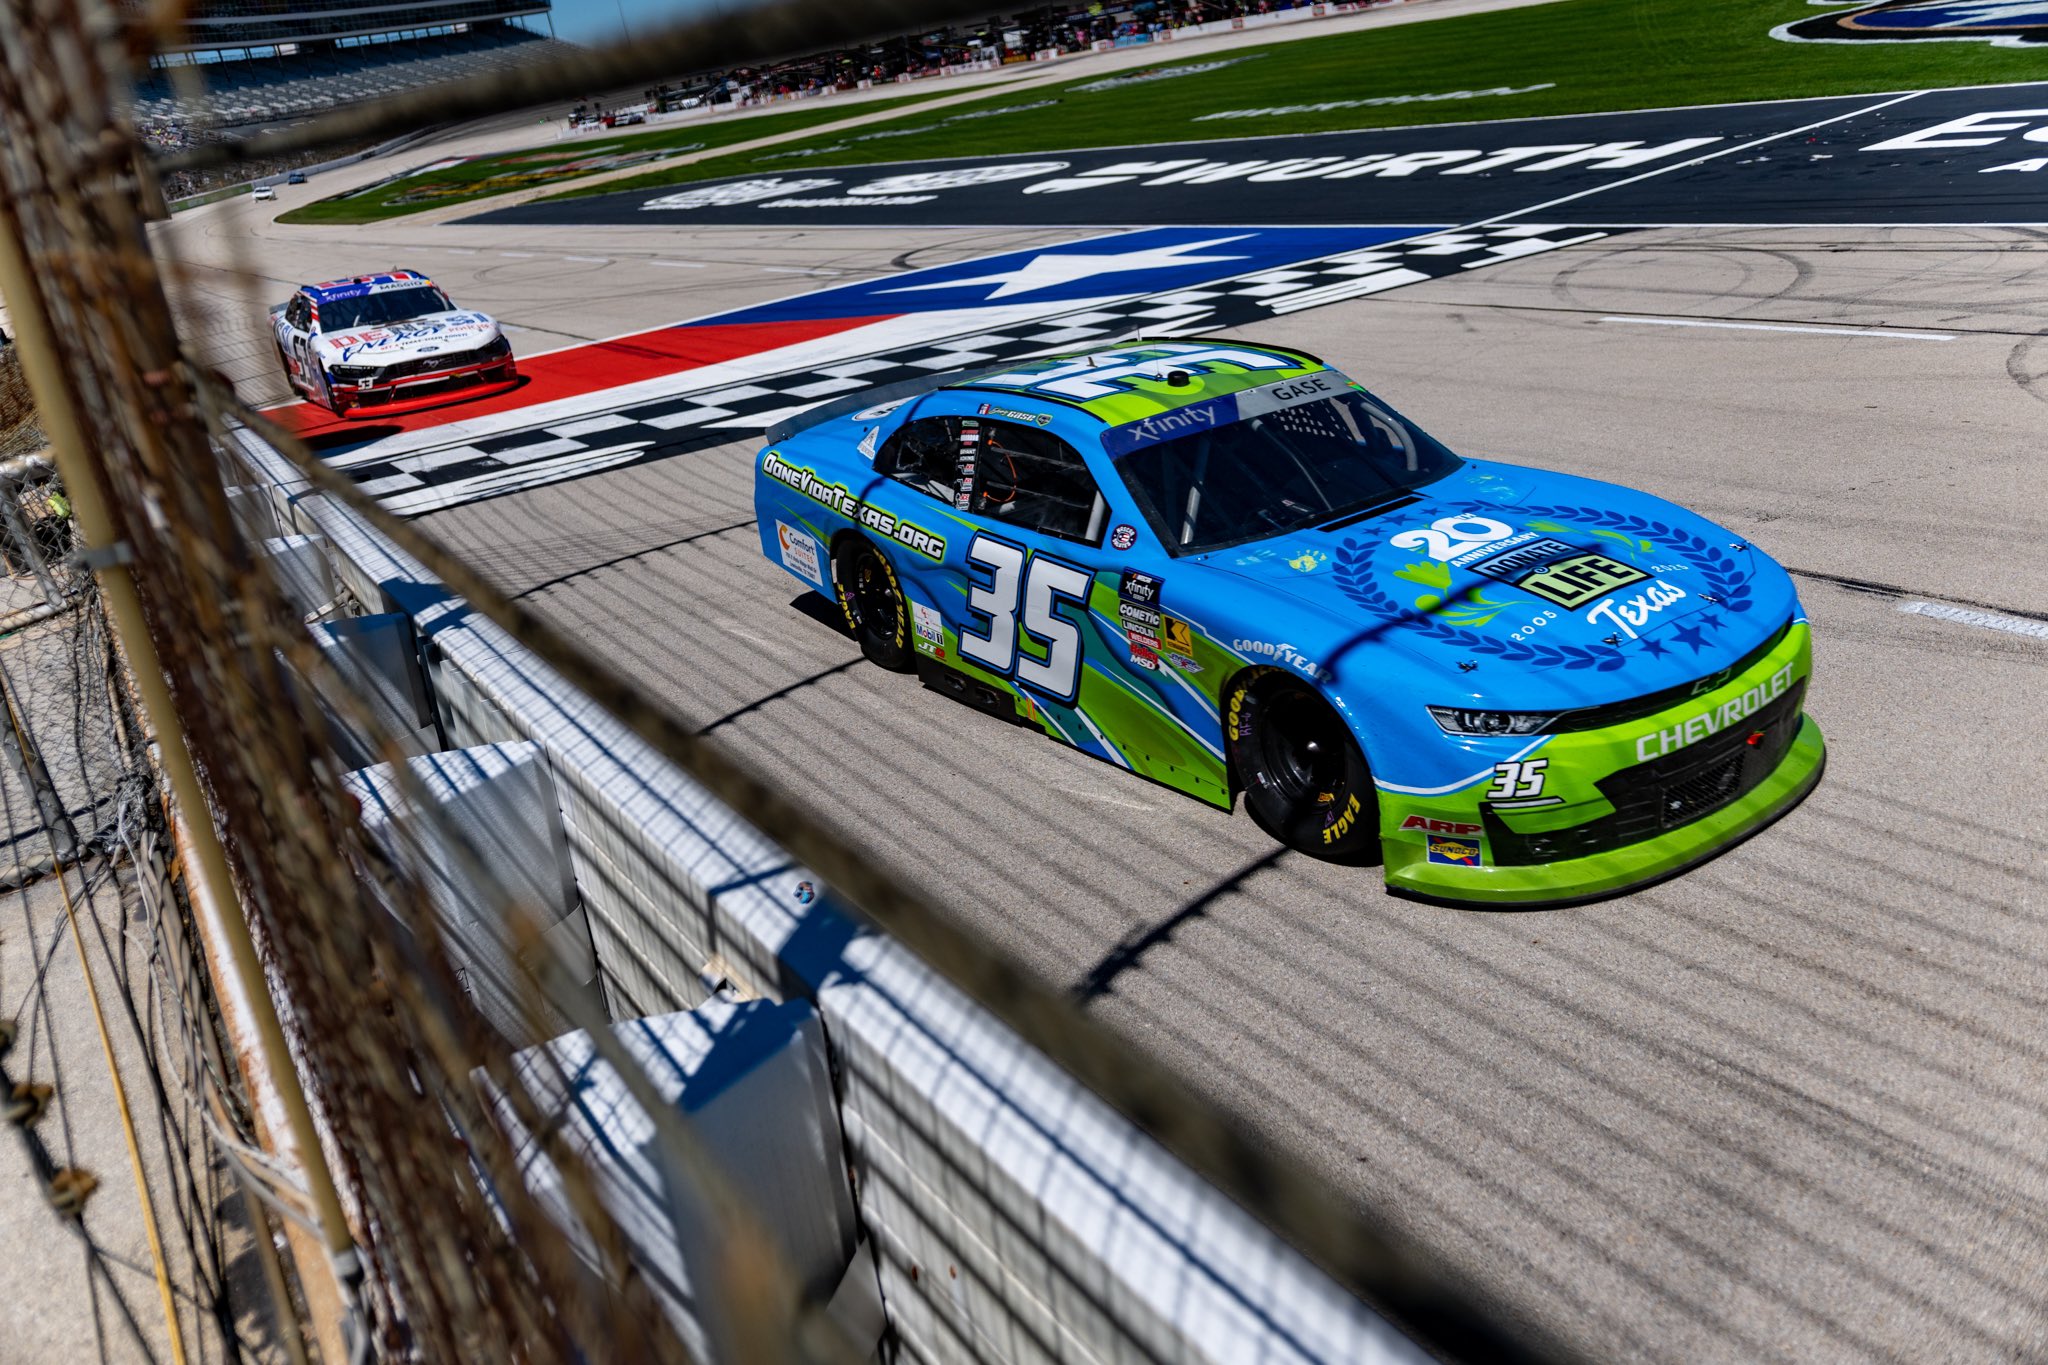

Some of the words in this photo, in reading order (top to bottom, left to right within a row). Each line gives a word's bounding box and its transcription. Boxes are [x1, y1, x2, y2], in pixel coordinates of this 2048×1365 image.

[325, 288, 362, 302] xfinity
[357, 377, 374, 390] 53
[1272, 378, 1332, 401] GASE
[1127, 403, 1216, 441] xfinity
[1389, 516, 1514, 563] 20
[1450, 531, 1541, 568] ANNIVERSARY
[1484, 542, 1570, 577] DONATE
[1125, 580, 1154, 600] xfinity
[1530, 558, 1636, 602] LIFE
[957, 528, 1099, 710] 35
[1119, 603, 1160, 626] COMETIC
[1510, 609, 1558, 642] 2005
[1586, 579, 1687, 640] Texas
[1122, 619, 1155, 638] LINCOLN
[1130, 654, 1157, 671] MSD
[1232, 638, 1334, 684] GOODYEAR
[1636, 662, 1794, 763] CHEVROLET
[1486, 758, 1549, 799] 35
[1322, 793, 1361, 845] EAGLE
[1401, 815, 1484, 835] ARP
[1430, 843, 1479, 856] SUNOCO
